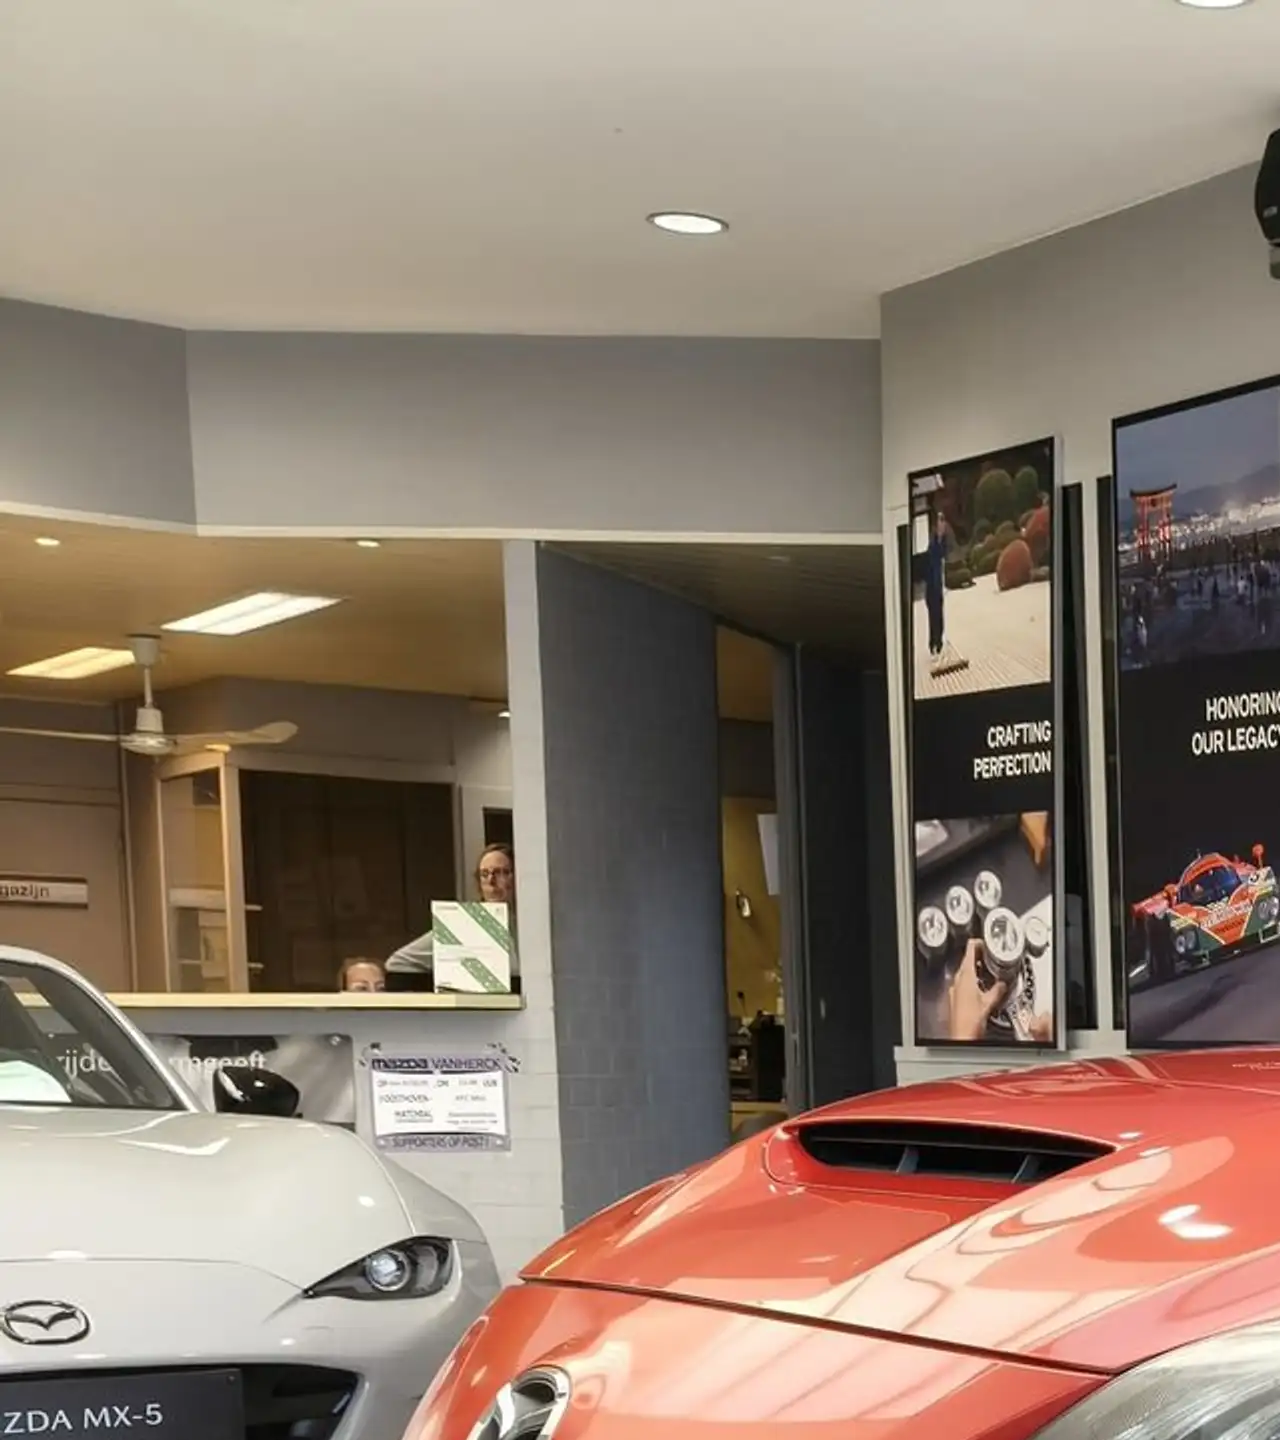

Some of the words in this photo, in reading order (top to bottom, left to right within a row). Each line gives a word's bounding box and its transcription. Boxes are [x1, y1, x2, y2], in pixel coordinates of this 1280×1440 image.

[987, 720, 1051, 748] CRAFTING
[1191, 730, 1224, 756] OUR
[973, 750, 1052, 780] PERFECTION
[0, 1409, 73, 1434] ZDA
[83, 1403, 163, 1429] MX-5
